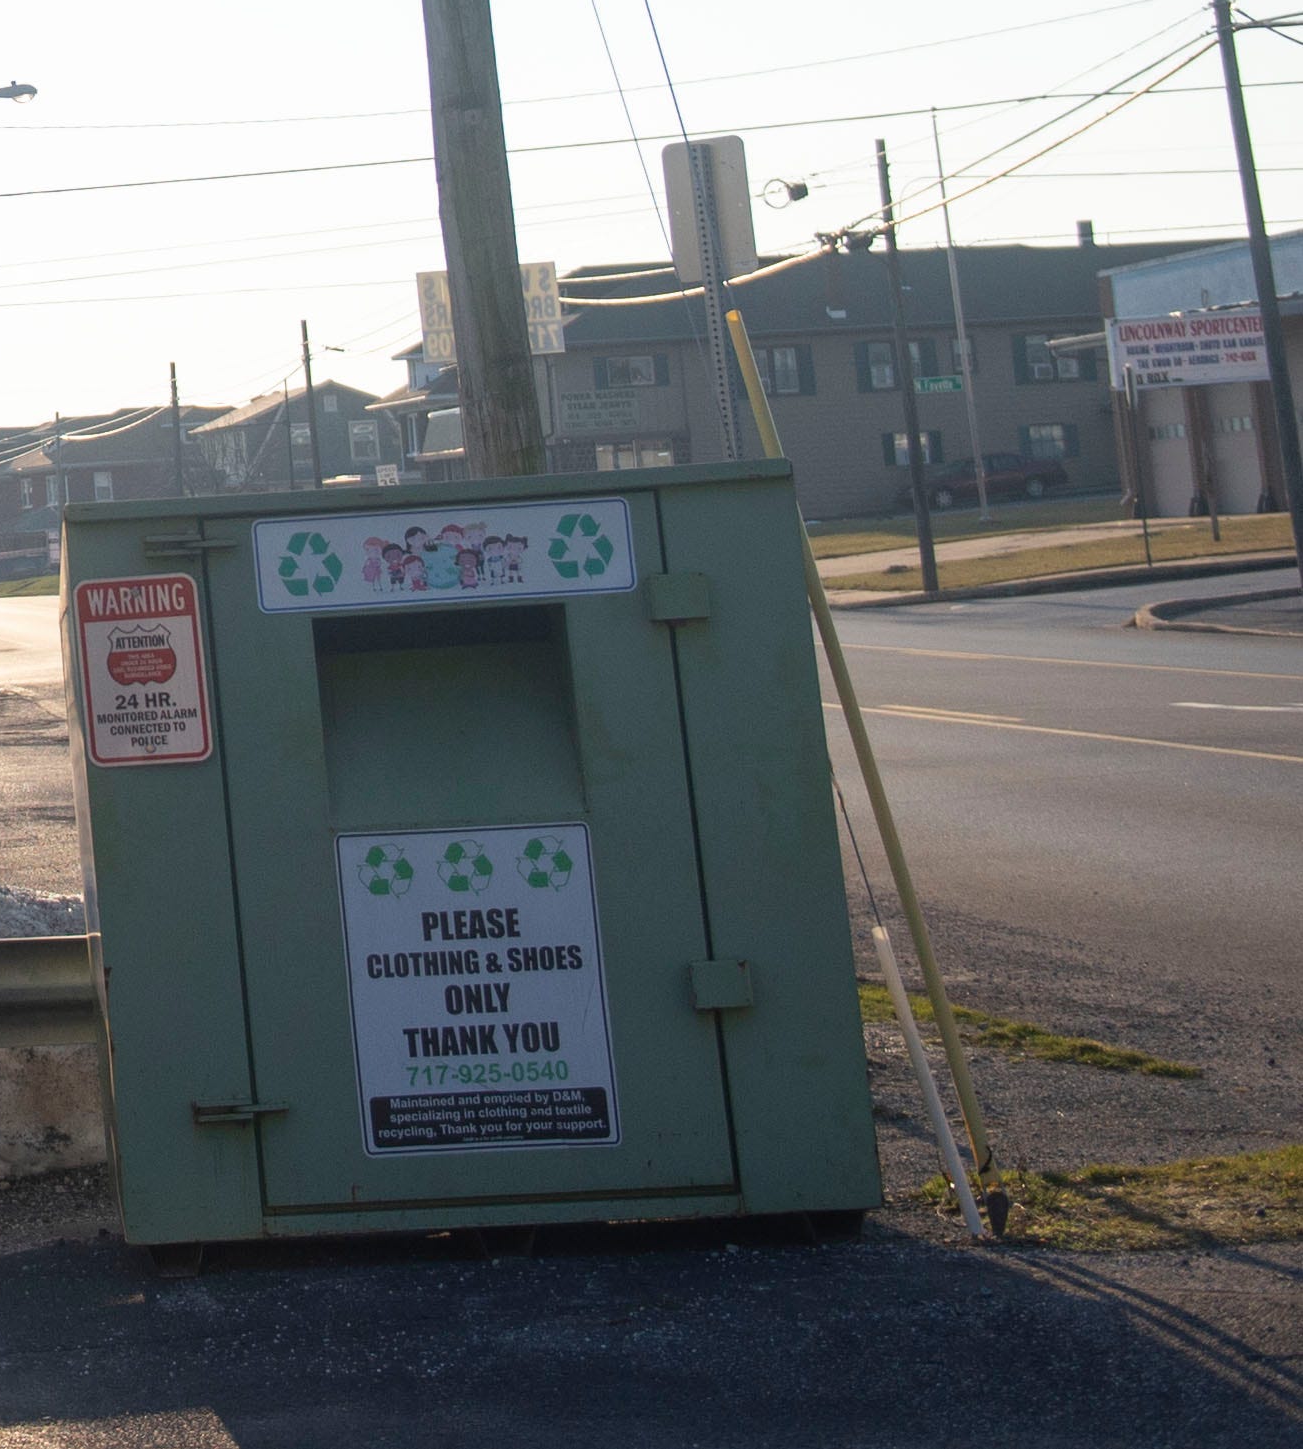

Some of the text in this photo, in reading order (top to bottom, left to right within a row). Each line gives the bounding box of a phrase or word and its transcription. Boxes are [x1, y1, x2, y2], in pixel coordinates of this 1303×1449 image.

[1119, 320, 1186, 342] LINCOLNWAY
[87, 583, 186, 617] WARNING
[115, 634, 165, 649] ATTENTION
[115, 692, 177, 710] 24 HR.
[97, 708, 198, 724] MONITORED ALARM
[110, 721, 186, 736] CONNECTED TO
[131, 735, 168, 747] POLICE
[421, 908, 521, 941] PLEASE
[366, 944, 583, 979] CLOTHING & SHOES
[444, 982, 511, 1015] ONLY
[403, 1021, 561, 1058] THANK YOU
[406, 1060, 569, 1086] 717-925-0540
[390, 1096, 455, 1110] Maintained
[458, 1094, 480, 1105] and
[483, 1092, 532, 1107] emptied
[535, 1091, 550, 1105] by
[390, 1103, 592, 1124] specializing in clothing and textile
[440, 1121, 477, 1135] Thank
[479, 1124, 503, 1136] you
[505, 1119, 522, 1132] for
[525, 1121, 553, 1134] your
[556, 1118, 607, 1132] support.
